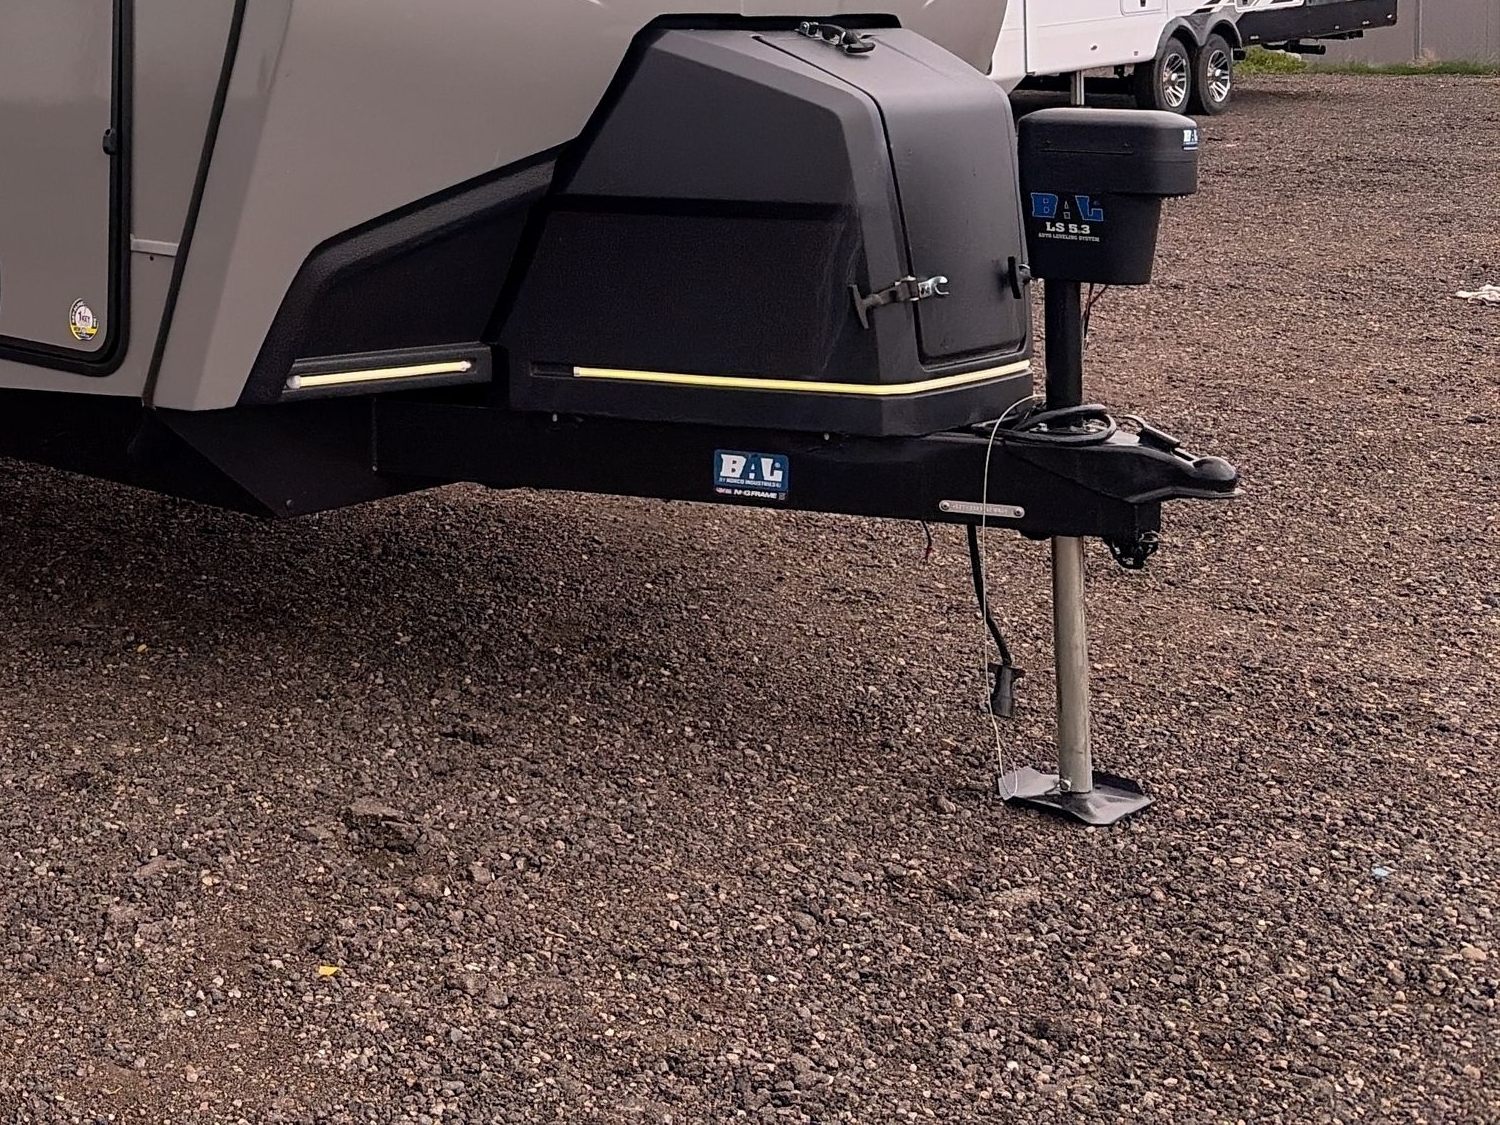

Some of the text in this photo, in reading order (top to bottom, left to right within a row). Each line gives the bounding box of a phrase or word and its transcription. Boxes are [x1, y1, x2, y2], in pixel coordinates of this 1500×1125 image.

[1045, 221, 1091, 235] LS 5.3
[719, 454, 783, 482] BAL
